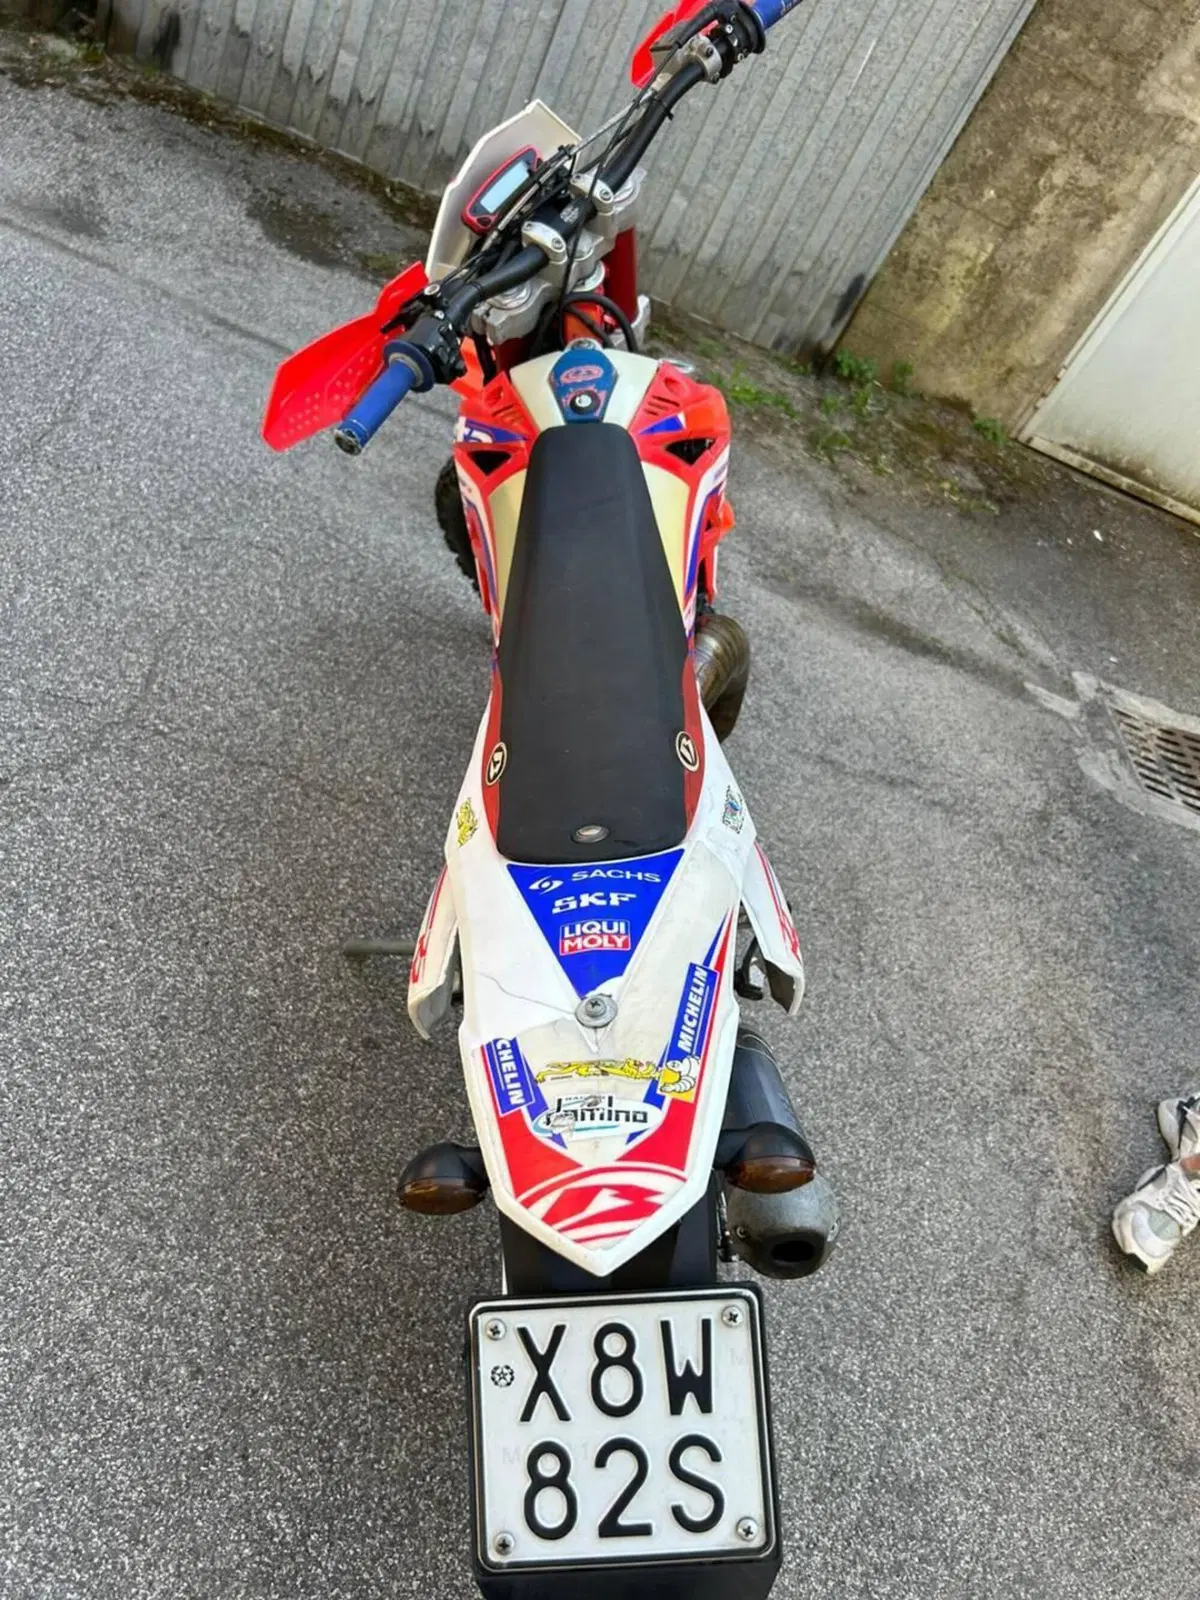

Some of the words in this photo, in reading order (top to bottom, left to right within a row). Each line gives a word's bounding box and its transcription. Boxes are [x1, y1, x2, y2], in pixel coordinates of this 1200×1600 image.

[571, 869, 661, 883] SACHS
[551, 892, 637, 914] SKF
[563, 920, 625, 938] LIQUI
[563, 934, 628, 956] MOLY
[677, 966, 708, 1054] MICHELIN
[515, 1317, 714, 1423] X8W
[523, 1433, 725, 1541] 82S
